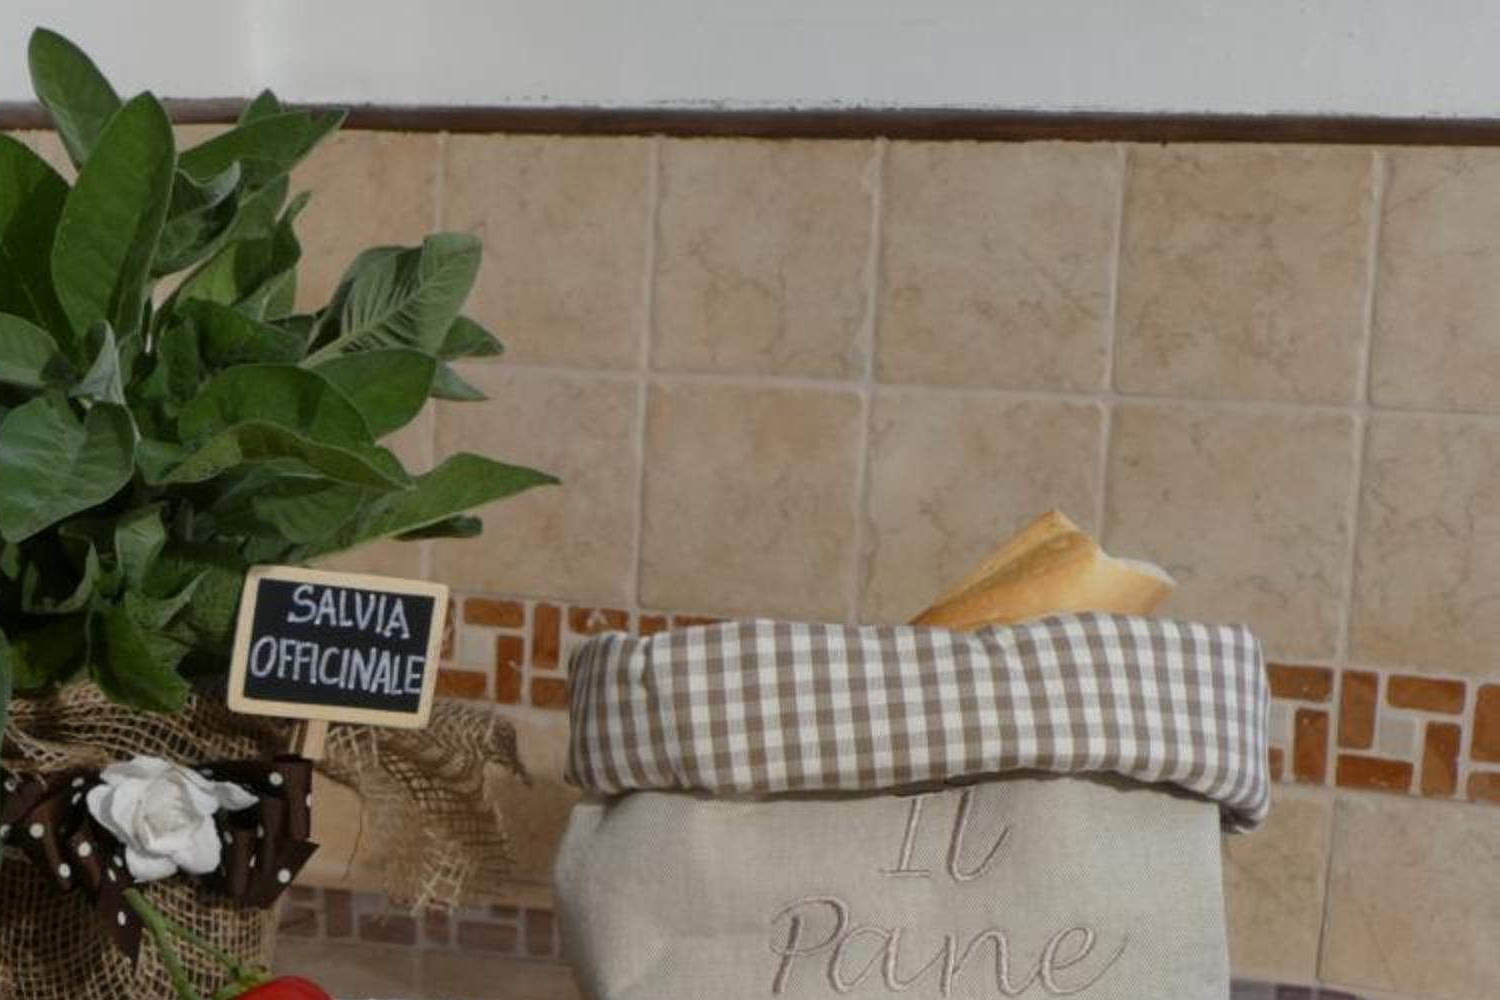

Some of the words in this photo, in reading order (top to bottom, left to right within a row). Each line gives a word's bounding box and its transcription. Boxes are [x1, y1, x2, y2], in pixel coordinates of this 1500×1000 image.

[286, 583, 411, 640] SALVIA
[249, 634, 426, 696] OFFICINALE
[769, 896, 1130, 998] Pane
